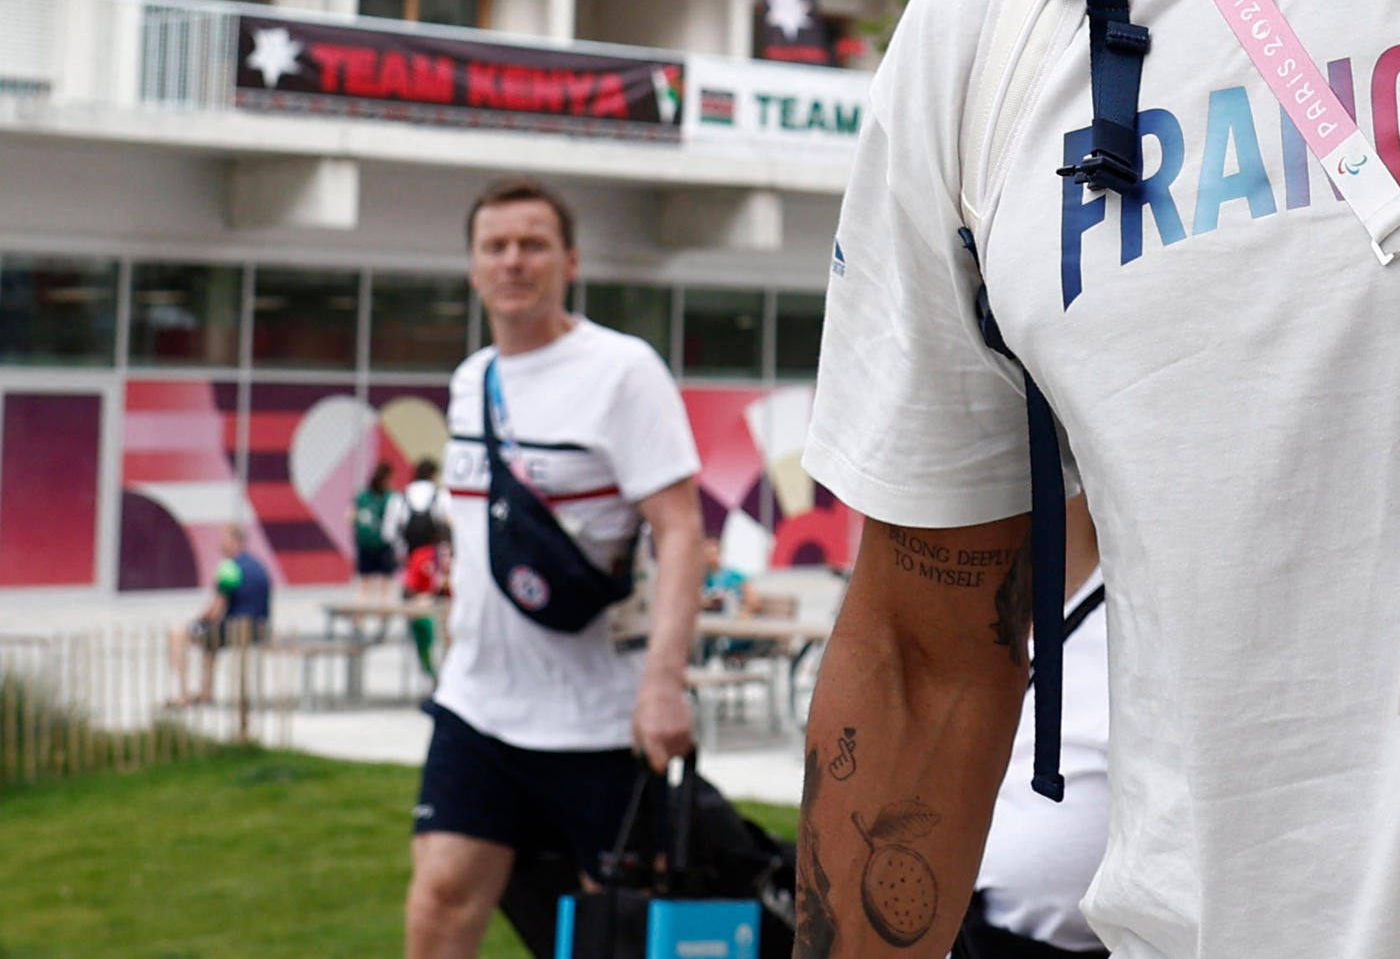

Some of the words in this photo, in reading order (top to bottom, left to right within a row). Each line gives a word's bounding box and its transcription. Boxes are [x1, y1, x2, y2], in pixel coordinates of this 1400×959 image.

[310, 43, 455, 104] TEAM
[467, 60, 629, 119] KENYA
[1277, 59, 1338, 138] PARIS
[755, 93, 862, 135] TEAM
[893, 548, 914, 571] TO
[919, 562, 986, 588] MYSELF
